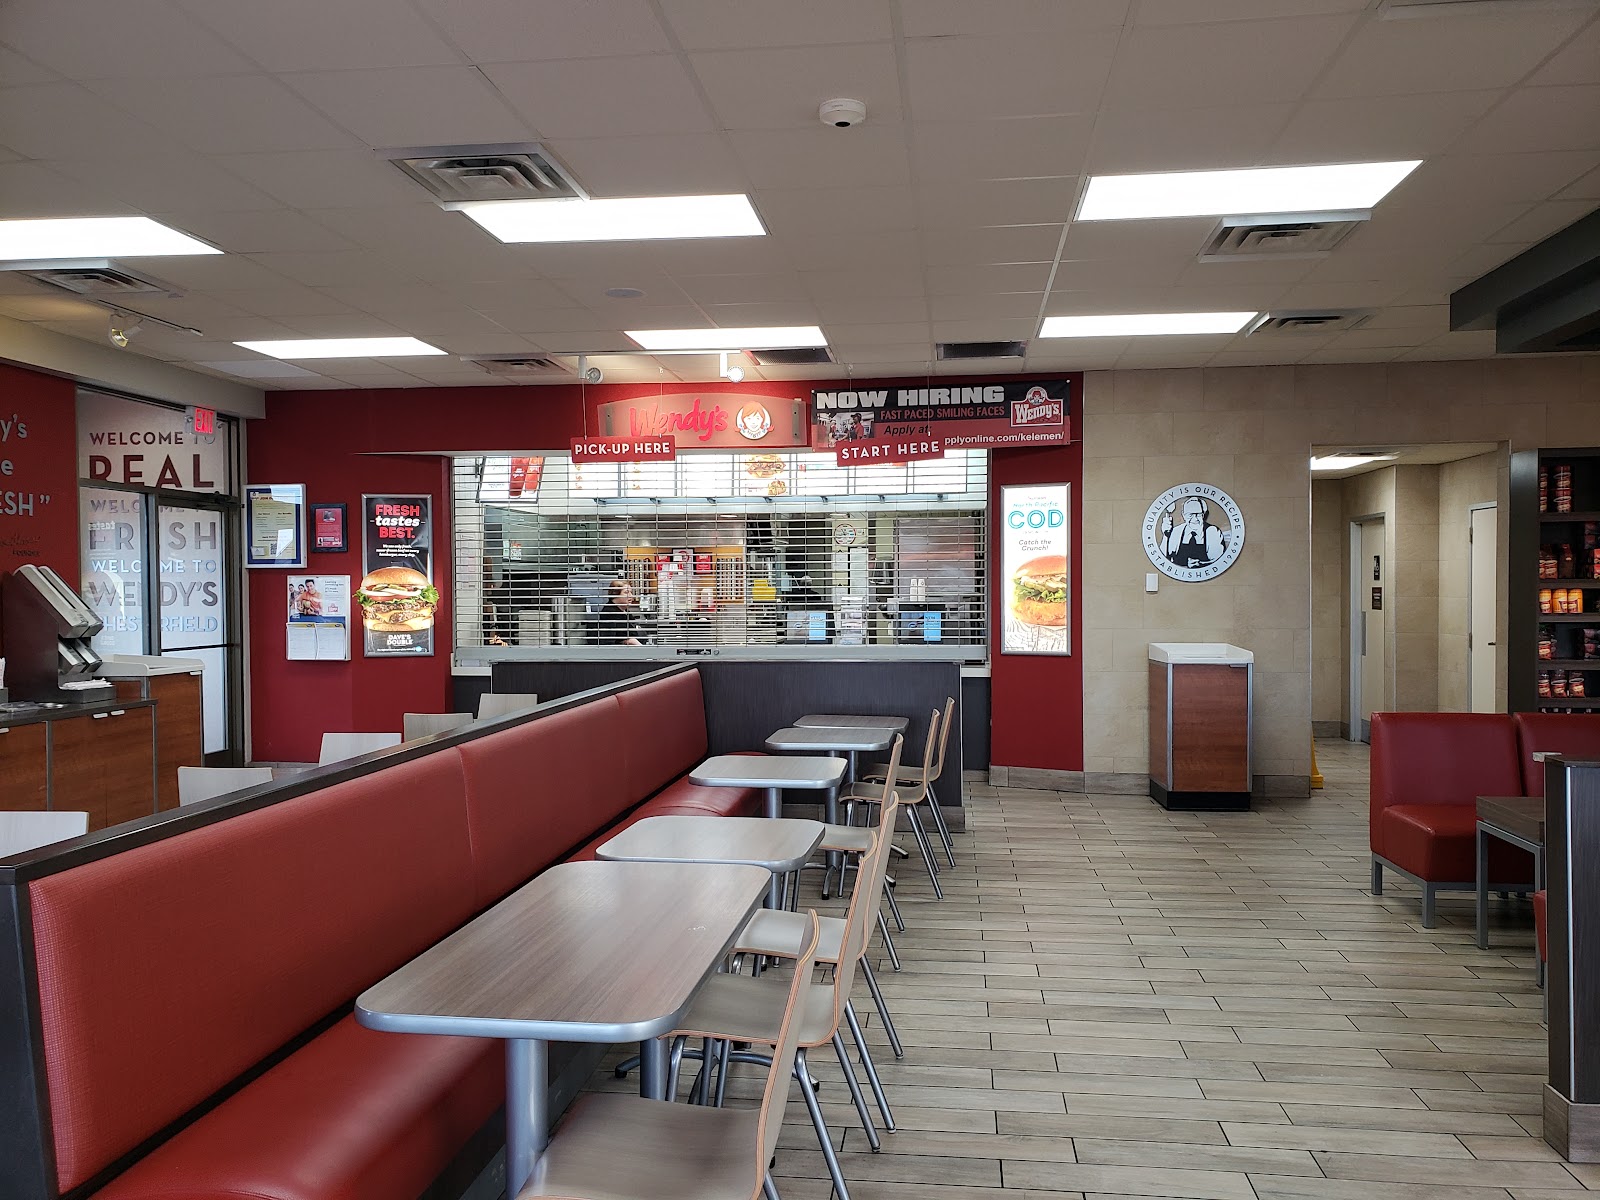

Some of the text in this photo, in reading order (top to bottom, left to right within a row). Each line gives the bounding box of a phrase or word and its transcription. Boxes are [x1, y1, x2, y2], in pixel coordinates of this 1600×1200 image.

[816, 386, 1005, 410] NOW HIRING
[194, 408, 213, 435] EXIT
[629, 399, 729, 442] Wendy's
[880, 406, 1005, 420] FAST PACED SMILING FACES
[1014, 402, 1061, 424] Wendy's
[89, 431, 185, 446] WELCOME
[884, 424, 916, 437] Apply
[944, 431, 1065, 446] pplyonline.com/kelemen/
[575, 442, 670, 455] PICK-UP HERE
[841, 441, 940, 459] START HERE
[89, 454, 215, 489] REAL
[0, 491, 51, 516] SH”
[90, 499, 185, 513] WELC
[375, 504, 420, 516] FRESH
[1146, 486, 1242, 531] QUALITY IS OUR RECIPE
[375, 515, 421, 527] tastes
[1008, 509, 1064, 529] COD
[89, 521, 217, 551] FRSH
[379, 526, 416, 538] BEST.
[1018, 538, 1039, 546] Catch
[91, 560, 217, 573] WELCME TO
[1147, 542, 1239, 578] ESTABLISHED 1969
[87, 581, 218, 607] WEDY'S
[102, 615, 218, 633] HESRFIELD
